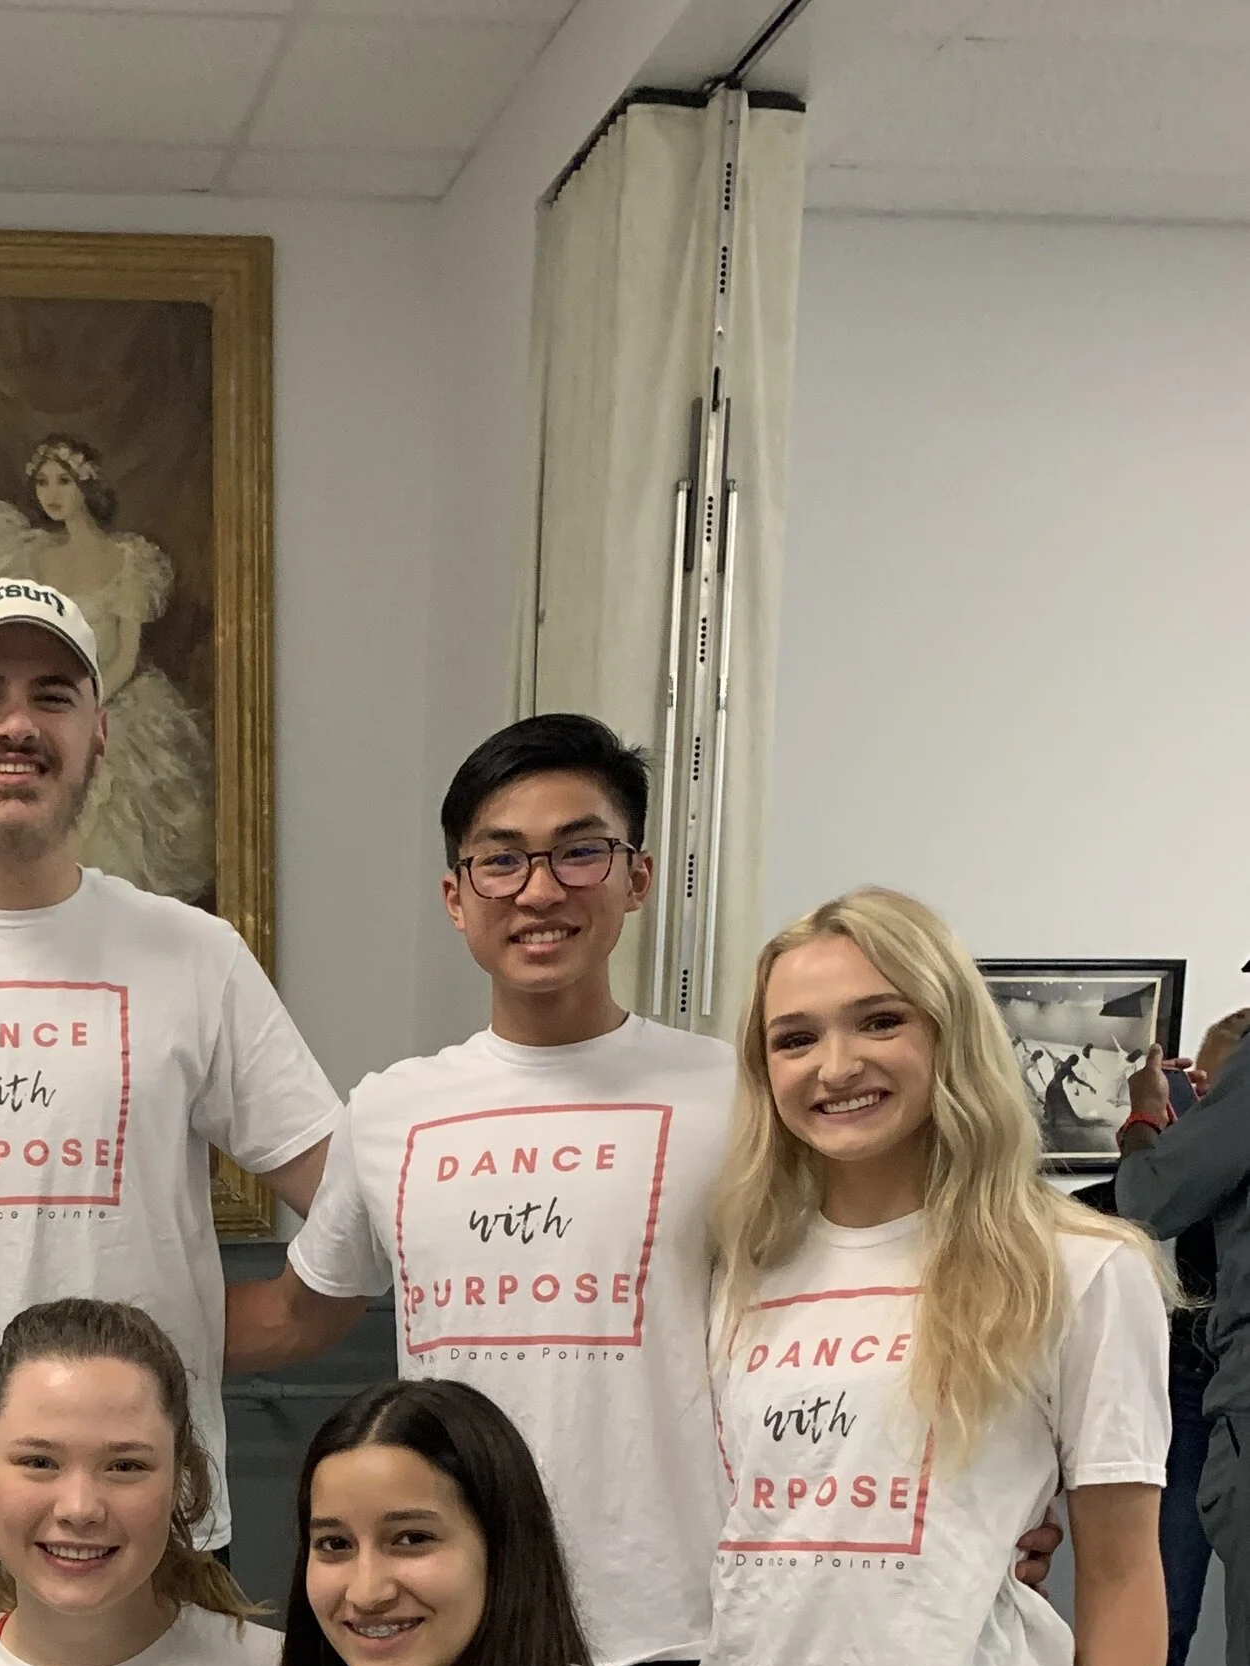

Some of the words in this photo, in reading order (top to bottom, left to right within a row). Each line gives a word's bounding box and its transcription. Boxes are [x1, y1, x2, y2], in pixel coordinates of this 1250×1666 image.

[437, 1143, 616, 1182] DANCE
[37, 1207, 107, 1220] Pointe
[469, 1196, 573, 1244] with
[410, 1273, 631, 1314] PURPOSE
[451, 1348, 525, 1360] Dance
[542, 1347, 625, 1361] Pointe
[746, 1334, 911, 1373] DANCE
[763, 1391, 858, 1444] with
[752, 1475, 910, 1510] RPOSE
[736, 1554, 797, 1567] Dance
[814, 1554, 905, 1570] Pointe
